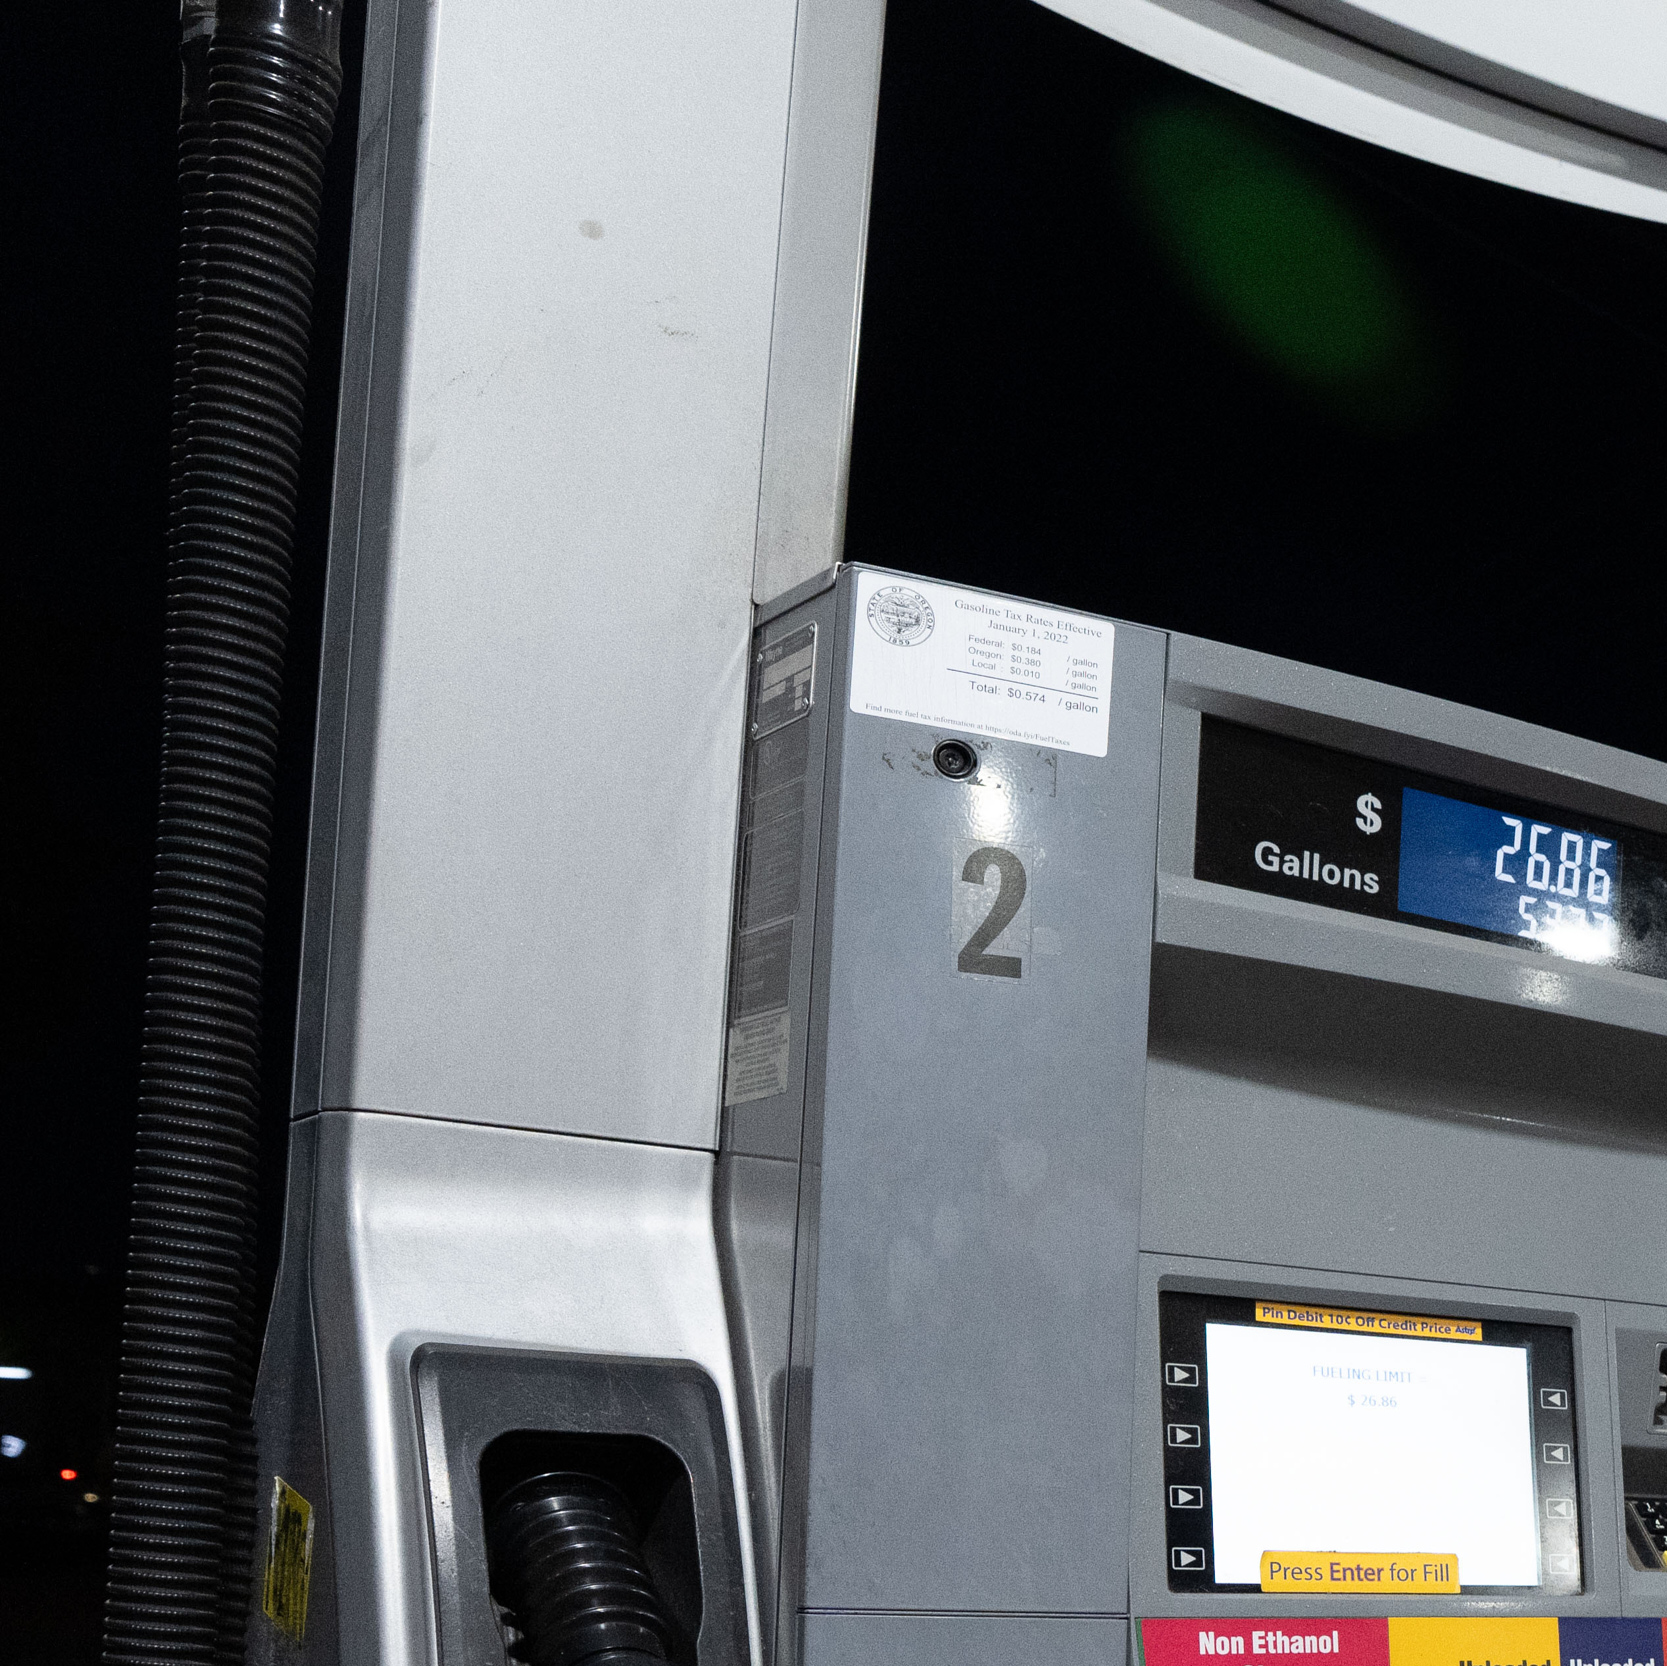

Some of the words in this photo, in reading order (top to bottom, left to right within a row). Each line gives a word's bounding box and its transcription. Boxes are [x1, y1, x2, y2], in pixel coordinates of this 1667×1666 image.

[954, 599, 1001, 617] Gasoline
[1003, 608, 1022, 621] Tax
[1025, 614, 1054, 628] Rates
[1056, 620, 1103, 639] Effective
[988, 619, 1028, 638] January
[1031, 628, 1041, 640] 1,
[1043, 630, 1069, 644] 2022
[968, 634, 1005, 649] Federal:
[1011, 642, 1042, 656] $0.184
[1072, 657, 1099, 670] gallon
[968, 646, 1004, 661] Oregon:
[1010, 654, 1042, 668] $0.380
[1071, 669, 1098, 682] gallon
[971, 659, 996, 672] Local
[1009, 666, 1041, 680] $0.010
[1070, 681, 1097, 694] gallon
[969, 680, 1001, 696] Total:
[1007, 687, 1046, 704] $0.574
[1065, 699, 1099, 715] gallon
[865, 703, 883, 713] Find
[883, 707, 903, 717] more
[904, 708, 919, 719] fuel
[920, 713, 932, 721] tax
[933, 715, 975, 730] information
[1355, 793, 1383, 835] $
[1254, 840, 1380, 894] Gallons
[1495, 816, 1612, 905] 26.86
[956, 845, 1027, 980] 2
[1262, 1306, 1284, 1320] Pin
[1287, 1309, 1324, 1324] Debit
[1327, 1313, 1351, 1326] 10¢
[1355, 1315, 1376, 1328] Off
[1378, 1318, 1418, 1332] Credit
[1421, 1321, 1452, 1335] Price
[1312, 1365, 1372, 1381] FUELING
[1375, 1369, 1414, 1384] LIMIT
[1347, 1393, 1356, 1407] $
[1361, 1394, 1398, 1408] 26.86
[1270, 1561, 1324, 1581] Press
[1329, 1562, 1384, 1582] Enter
[1390, 1562, 1417, 1582] for
[1423, 1563, 1450, 1582] Fill
[1198, 1630, 1245, 1656] Non
[1251, 1630, 1340, 1655] Ethanol
